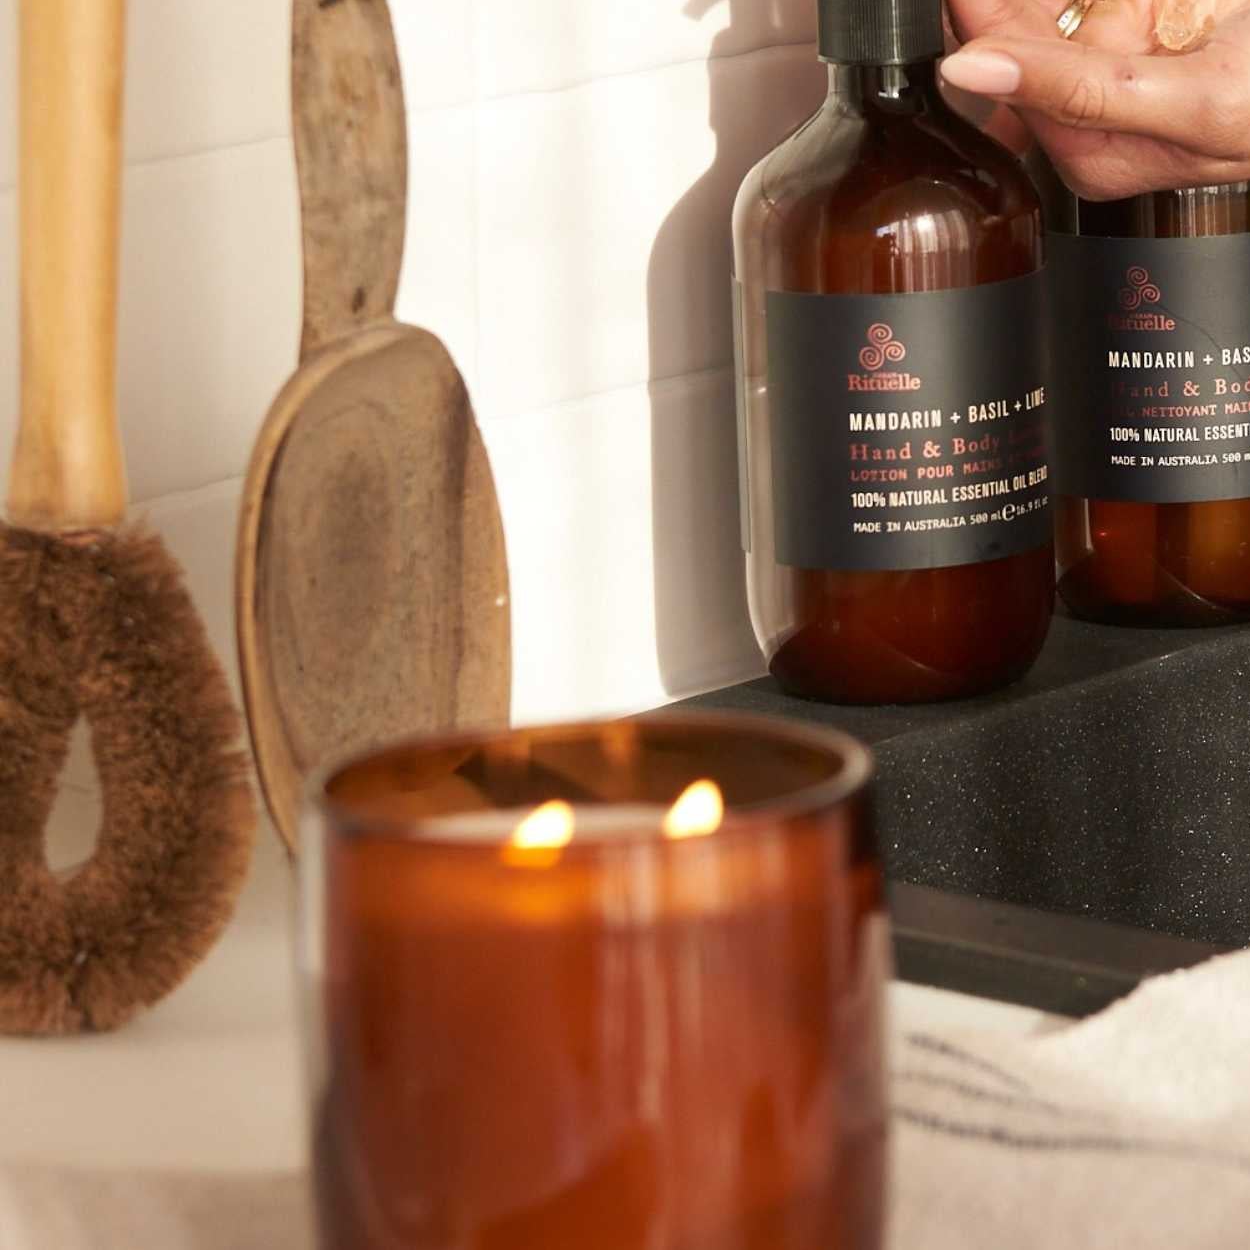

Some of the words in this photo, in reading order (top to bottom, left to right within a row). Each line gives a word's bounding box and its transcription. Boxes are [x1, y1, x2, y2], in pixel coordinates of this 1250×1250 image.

[1109, 351, 1194, 368] MANDARIN
[1203, 355, 1213, 365] +
[1183, 381, 1200, 396] &
[850, 410, 942, 431] MANDARIN
[950, 412, 961, 424] +
[969, 400, 1009, 423] BASIL
[1026, 387, 1045, 409] LIME
[1142, 405, 1217, 417] NETTOYANT
[1110, 427, 1140, 442] 100%
[1145, 427, 1199, 442] NATURAL
[850, 442, 912, 460] Hand
[923, 441, 941, 458] &
[952, 433, 1000, 455] Body
[1111, 456, 1136, 465] MADE
[1141, 457, 1153, 466] IN
[1158, 455, 1218, 466] AUSTRALIA
[1222, 452, 1240, 463] 500
[850, 469, 907, 481] LOTION
[918, 466, 953, 479] POUR
[852, 493, 886, 508] 100%
[889, 489, 948, 507] NATURAL
[952, 480, 1010, 502] ESSENTIAL
[1013, 476, 1027, 490] OIL
[854, 522, 881, 533] MADE
[887, 522, 900, 532] IN
[905, 516, 966, 531] AUSTRALIA
